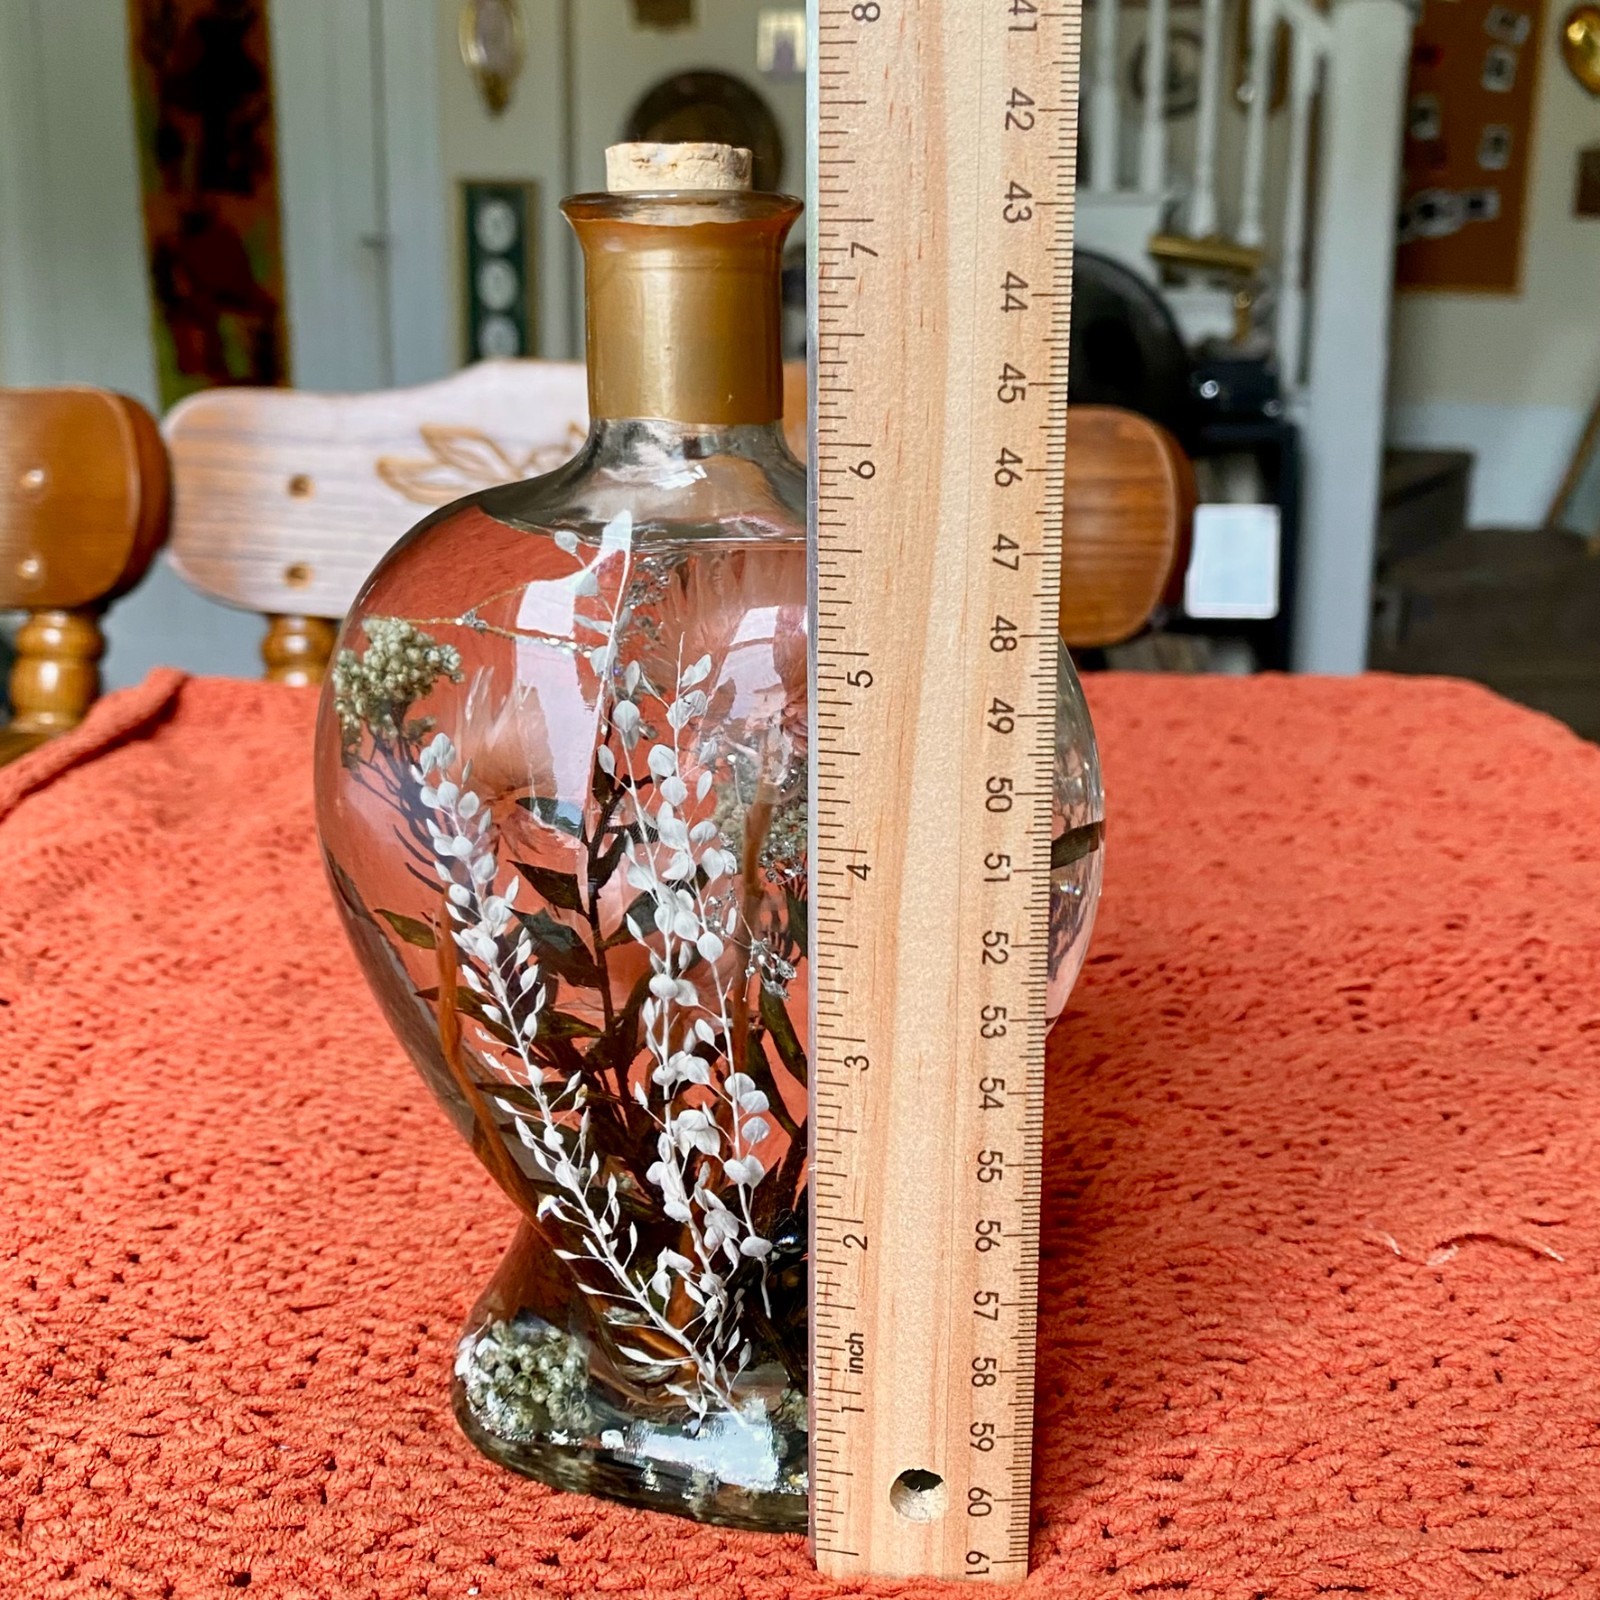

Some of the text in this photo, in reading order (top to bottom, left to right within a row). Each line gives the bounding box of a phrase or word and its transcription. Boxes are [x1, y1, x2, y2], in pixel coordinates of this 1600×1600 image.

[851, 2, 880, 22] 8
[1008, 0, 1038, 31] 41
[1005, 87, 1035, 131] 42
[1003, 180, 1032, 223] 43
[851, 242, 878, 258] 7
[1000, 271, 1028, 313] 44
[997, 363, 1026, 404] 45
[849, 460, 875, 479] 6
[995, 447, 1023, 487] 46
[992, 533, 1019, 571] 47
[990, 615, 1018, 652] 48
[847, 670, 873, 688] 5
[987, 697, 1014, 734] 49
[985, 776, 1013, 813] 50
[846, 864, 871, 881] 4
[984, 852, 1010, 882] 51
[982, 930, 1009, 965] 52
[980, 1005, 1007, 1039] 53
[844, 1055, 869, 1072] 3
[979, 1077, 1005, 1111] 54
[977, 1150, 1003, 1183] 55
[843, 1234, 868, 1251] 2
[975, 1220, 1001, 1252] 56
[973, 1291, 999, 1321] 57
[844, 1333, 864, 1374] inch
[971, 1357, 997, 1387] 58
[970, 1422, 994, 1452] 59
[967, 1487, 992, 1517] 60
[966, 1551, 990, 1575] 61
